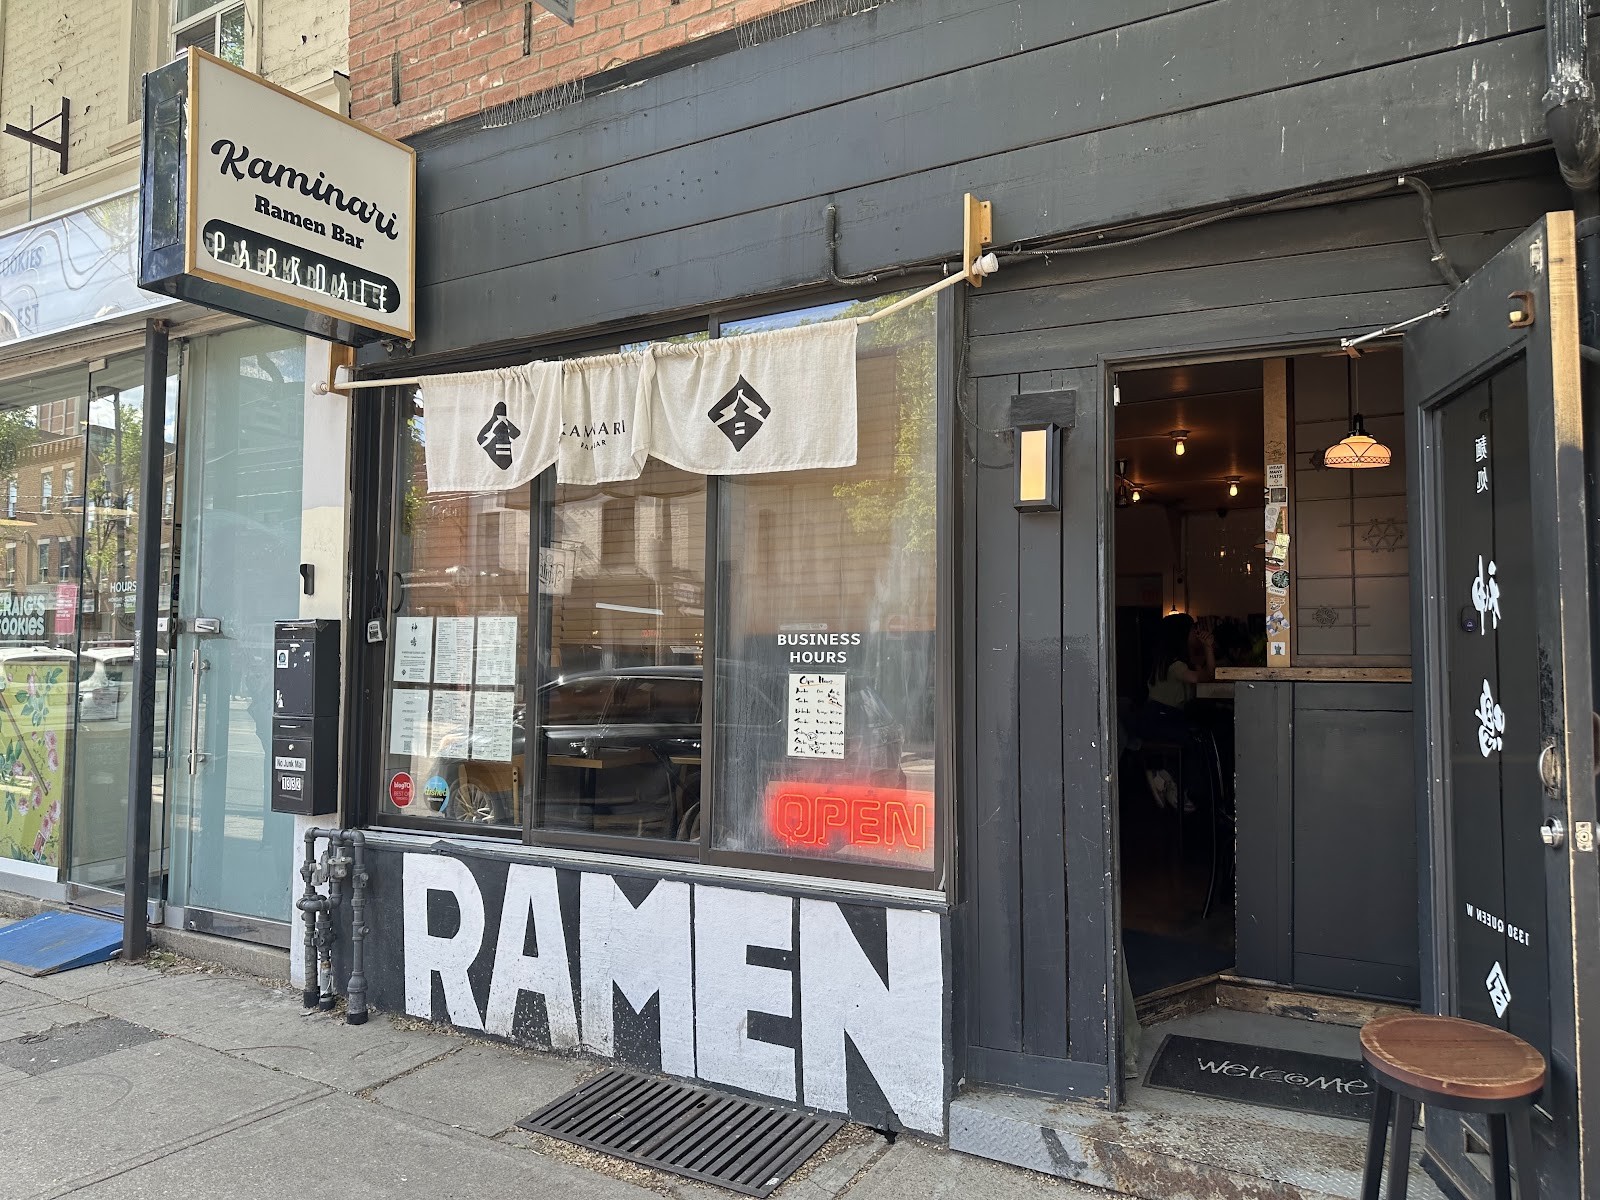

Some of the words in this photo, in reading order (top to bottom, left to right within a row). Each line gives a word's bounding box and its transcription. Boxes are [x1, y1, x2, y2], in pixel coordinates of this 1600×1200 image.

[210, 139, 399, 240] Kaminari
[254, 194, 326, 236] Ramen
[331, 222, 365, 250] Bar
[206, 231, 388, 312] PARKDALE
[110, 580, 137, 593] HOURS
[0, 594, 45, 617] RAIG'S
[777, 633, 861, 646] BUSINESS
[789, 651, 847, 664] HOURS
[276, 758, 283, 767] No
[283, 759, 294, 768] Junk
[294, 759, 305, 769] Mail
[393, 781, 411, 789] blogTO
[776, 794, 926, 851] OPEN
[402, 852, 944, 1137] RAMEN
